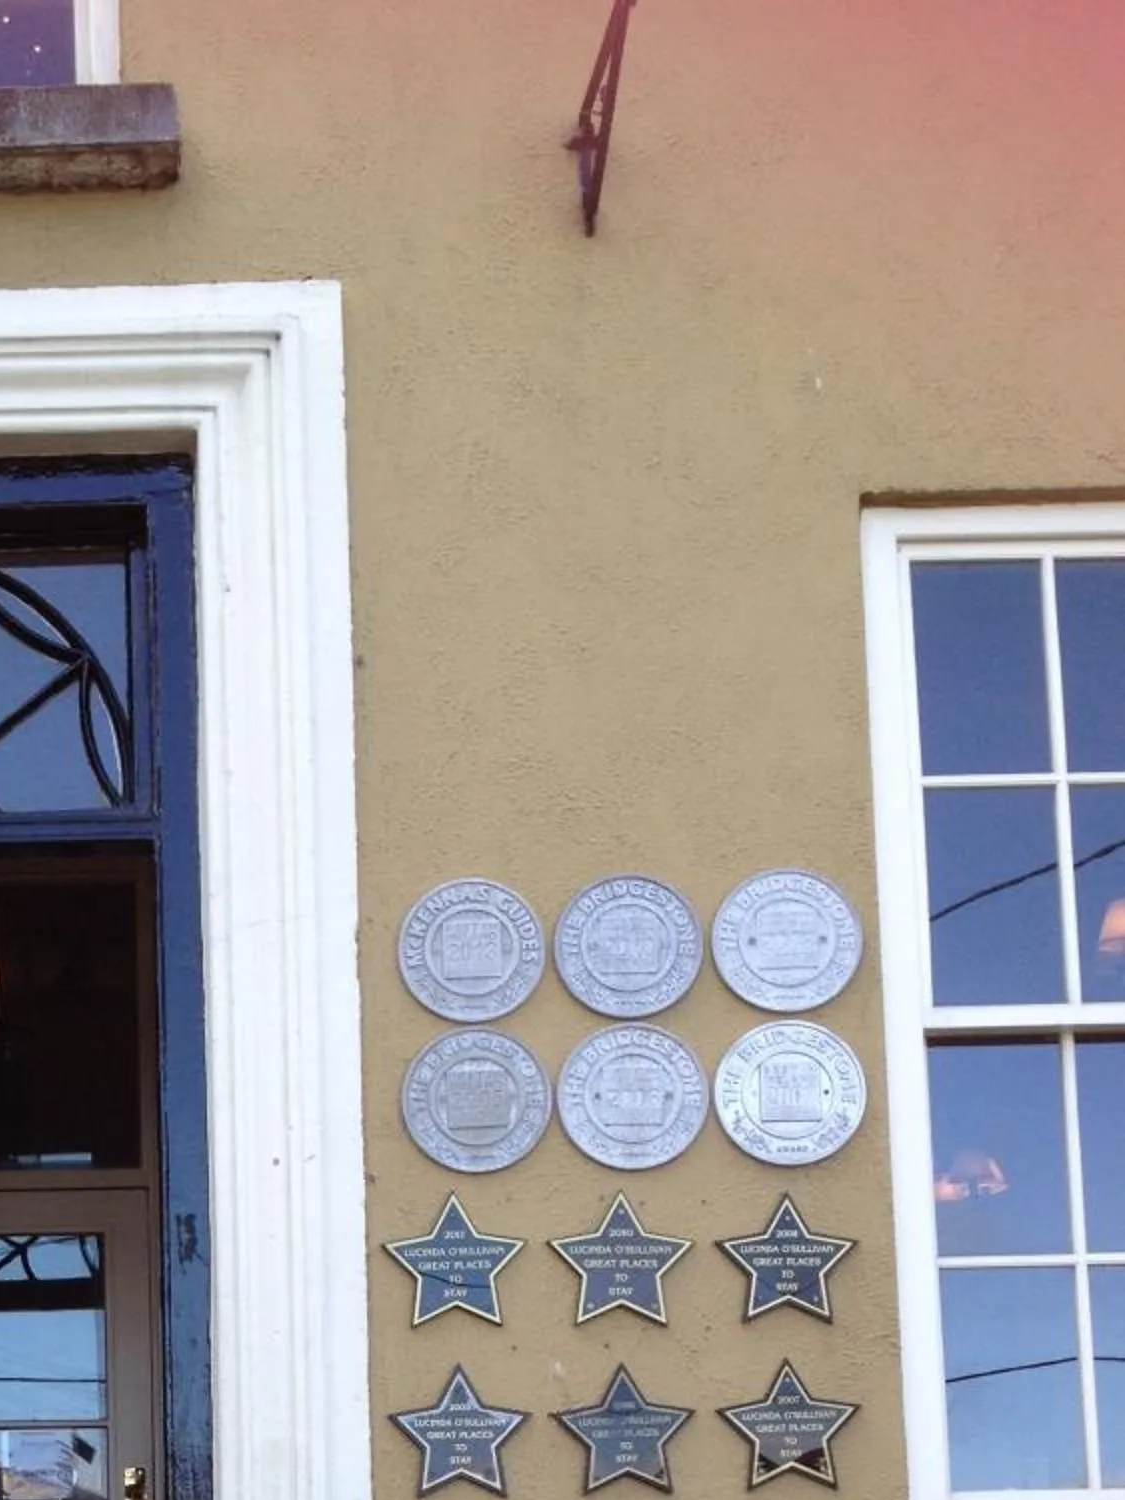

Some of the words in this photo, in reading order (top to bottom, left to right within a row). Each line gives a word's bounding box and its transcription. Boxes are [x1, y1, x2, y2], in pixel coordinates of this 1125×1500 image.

[577, 880, 695, 957] BRIDGESTONE
[418, 1261, 451, 1271] GREAT
[584, 1259, 617, 1269] GREAT
[752, 1257, 784, 1267] GREAT
